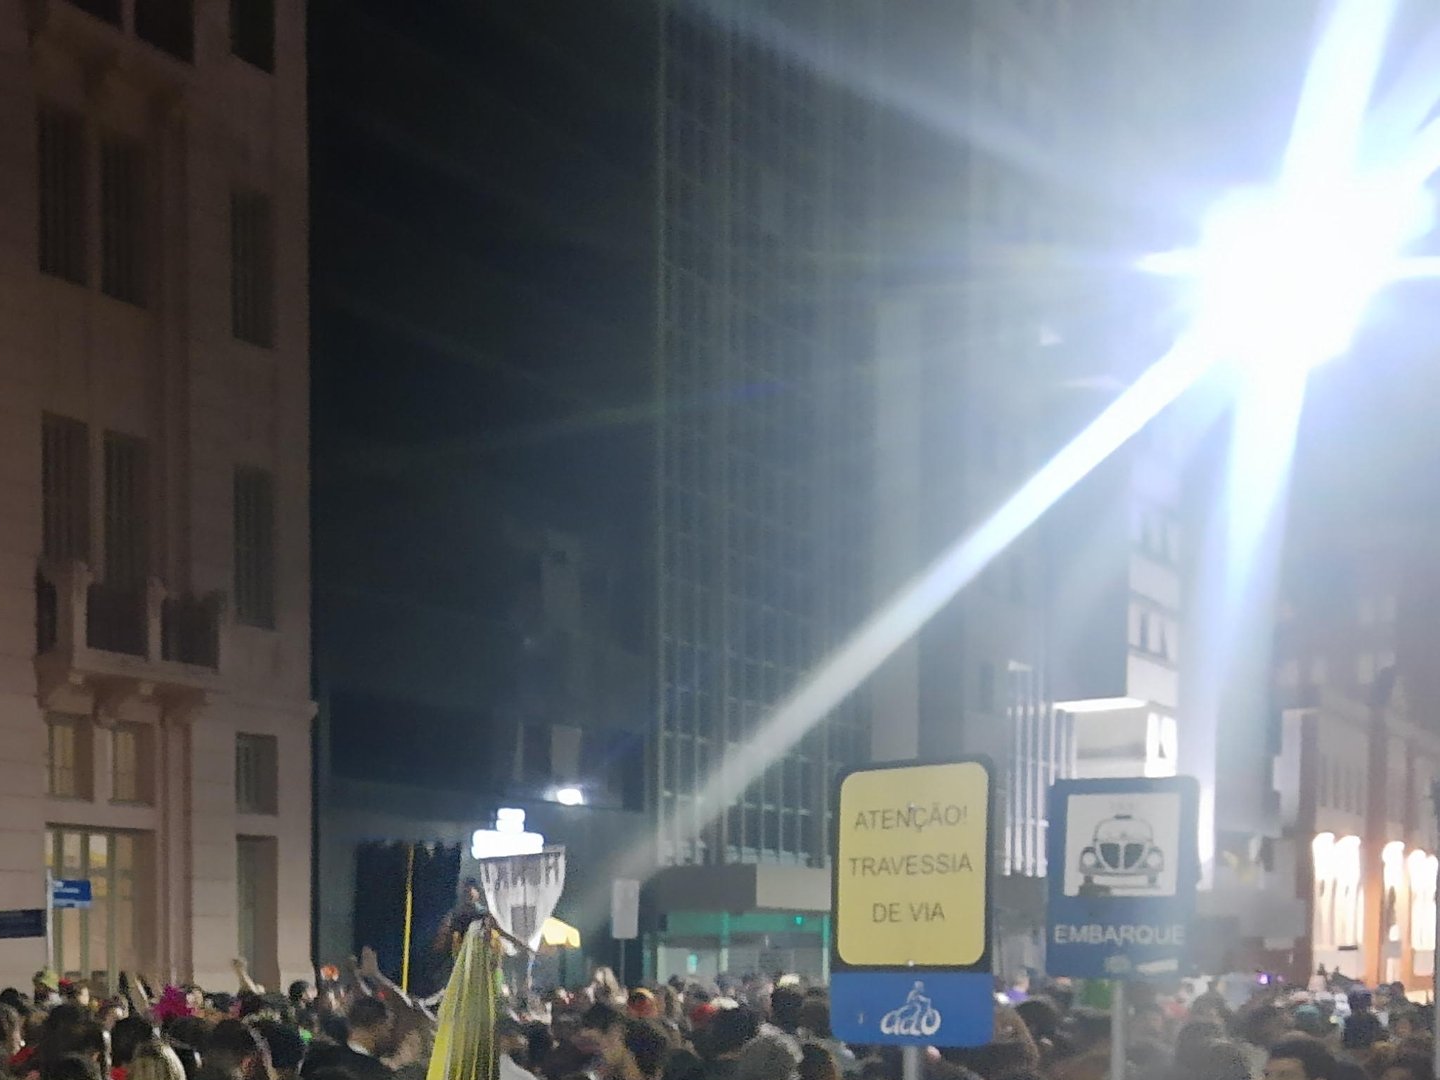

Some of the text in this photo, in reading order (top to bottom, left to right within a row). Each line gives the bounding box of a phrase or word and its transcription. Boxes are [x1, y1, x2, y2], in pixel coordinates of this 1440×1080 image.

[854, 804, 968, 832] ATENÇÃO!
[849, 853, 973, 876] TRAVESSIA
[872, 902, 945, 923] DE VIA
[1054, 924, 1185, 946] EMBARQUE
